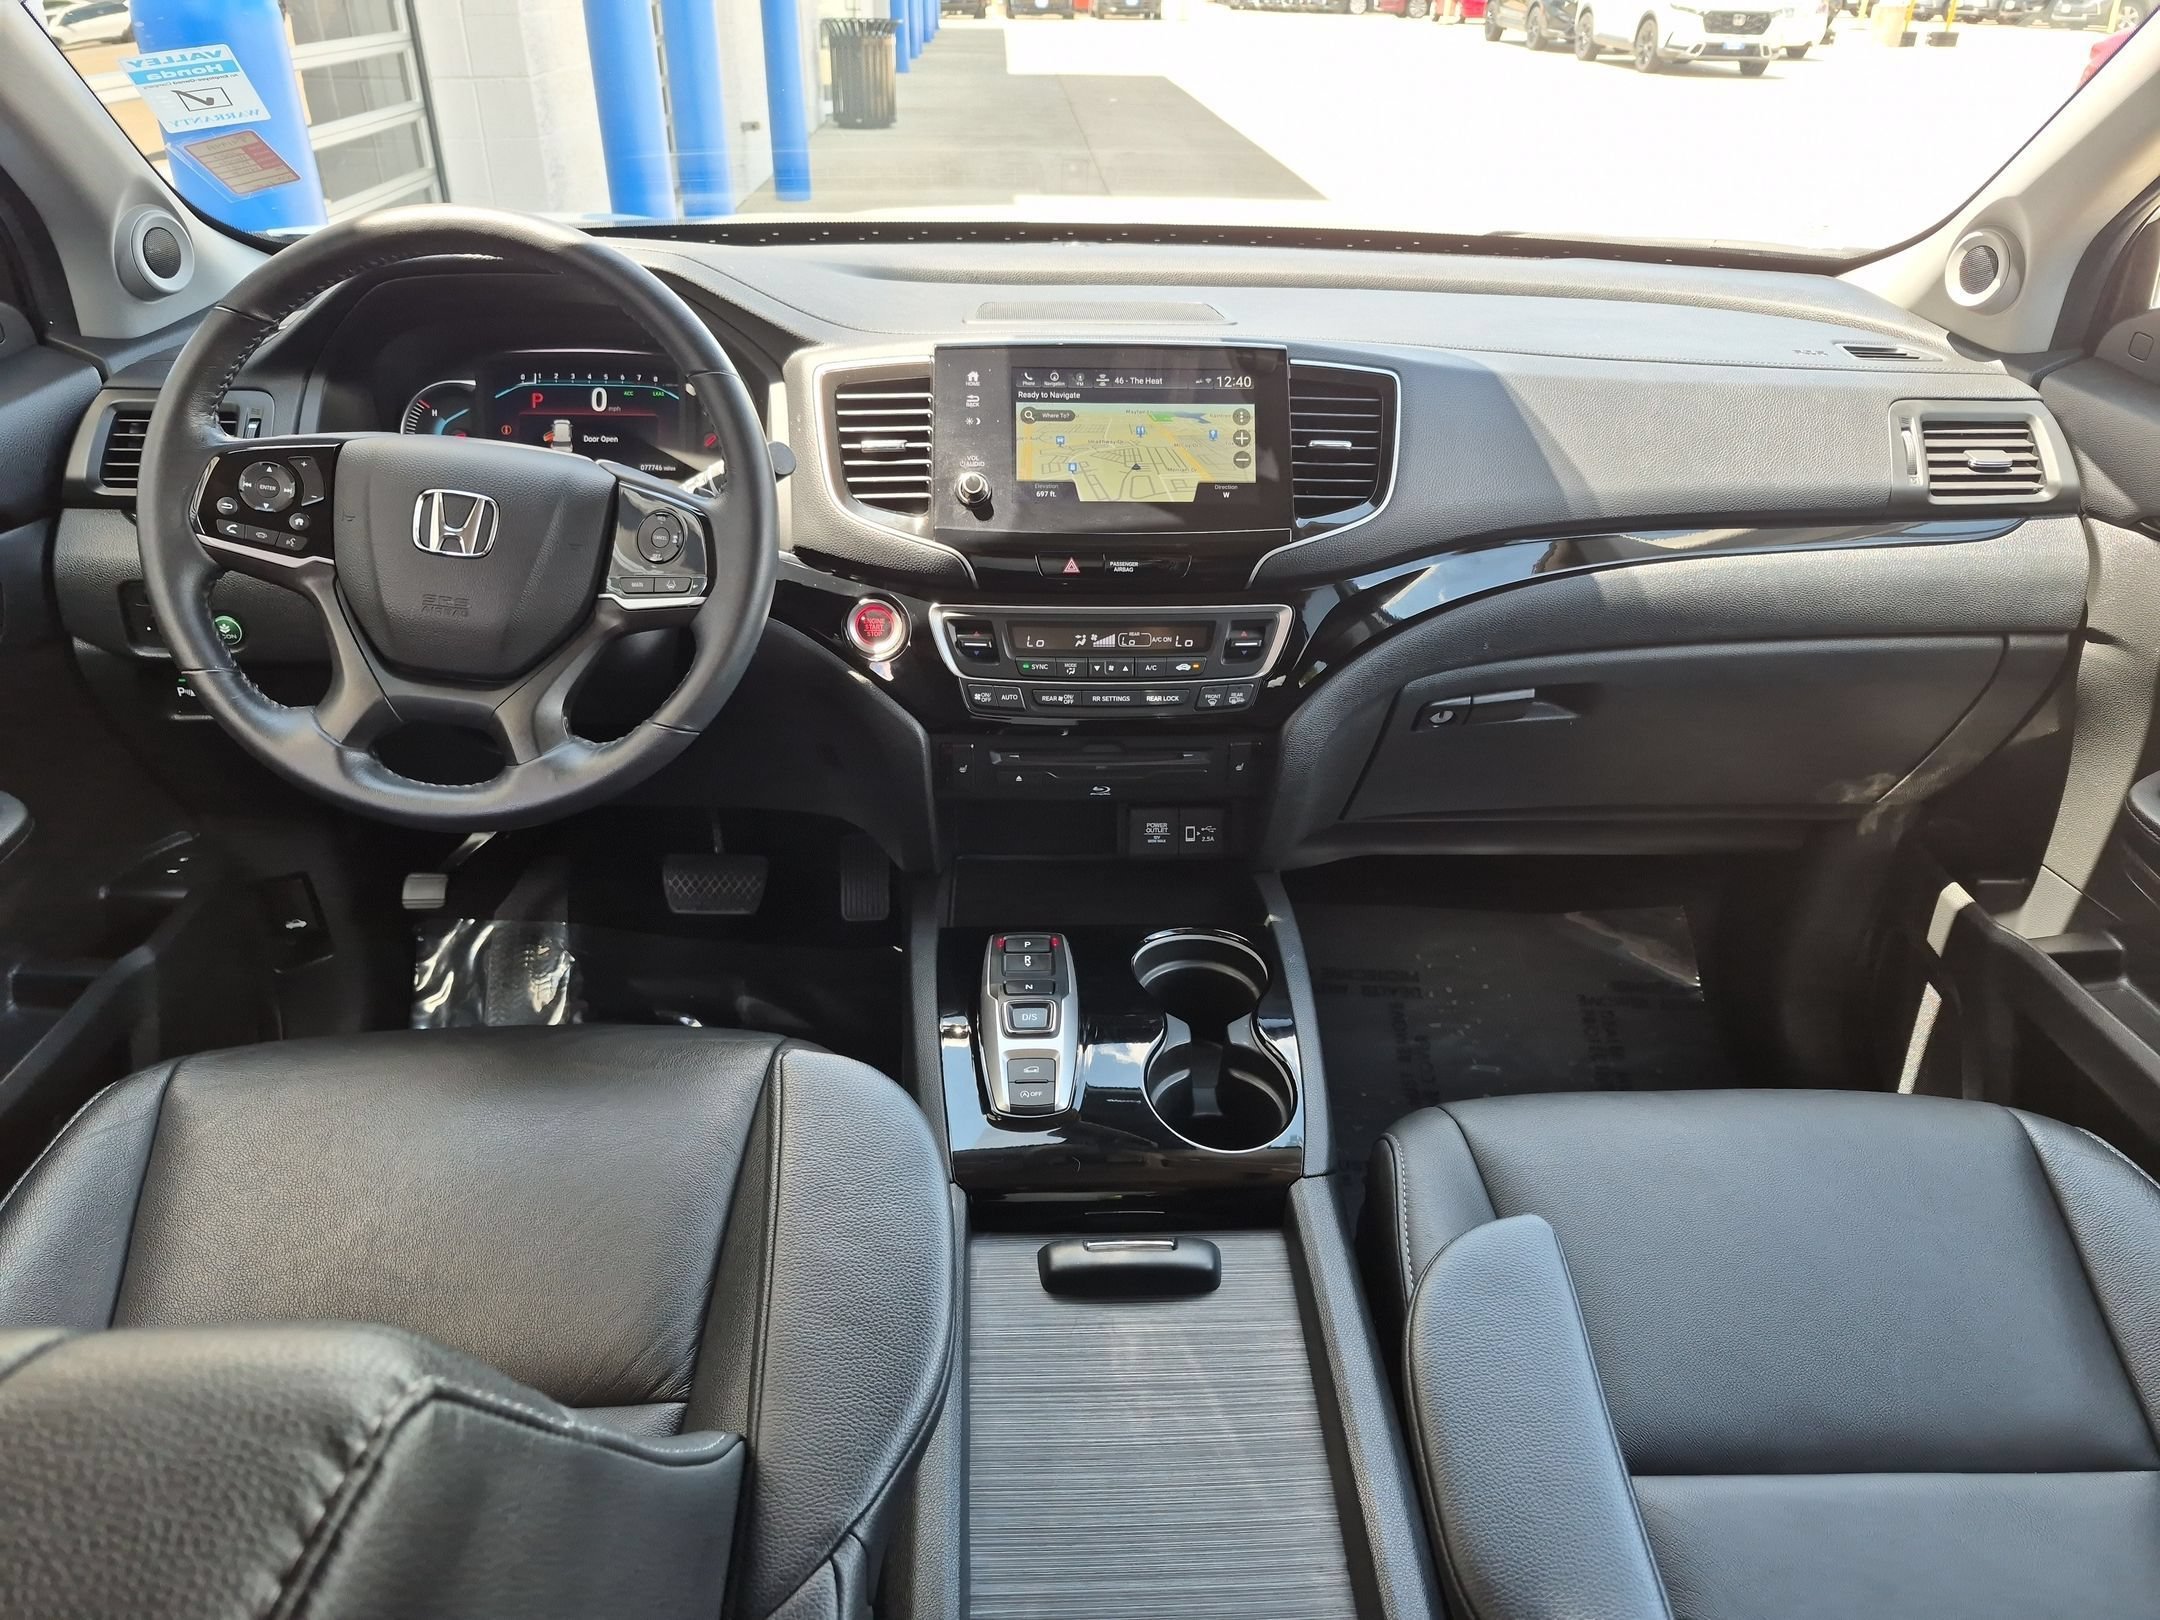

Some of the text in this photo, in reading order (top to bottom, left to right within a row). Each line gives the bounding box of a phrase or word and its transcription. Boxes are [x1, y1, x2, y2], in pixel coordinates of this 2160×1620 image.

[1114, 377, 1124, 385] 46
[1130, 377, 1144, 385] The
[1145, 377, 1163, 385] Heat
[1216, 376, 1252, 388] 12:40
[591, 387, 607, 412] 0
[1018, 391, 1081, 400] Ready to Navigate
[531, 392, 544, 408] P
[583, 435, 619, 444] Door Open
[259, 484, 277, 492] ENTER
[1035, 490, 1057, 498] 697 ft.
[1031, 663, 1049, 671] SYNC
[1145, 664, 1158, 672] A/C
[1024, 955, 1031, 964] R
[1021, 1013, 1038, 1021] D/S
